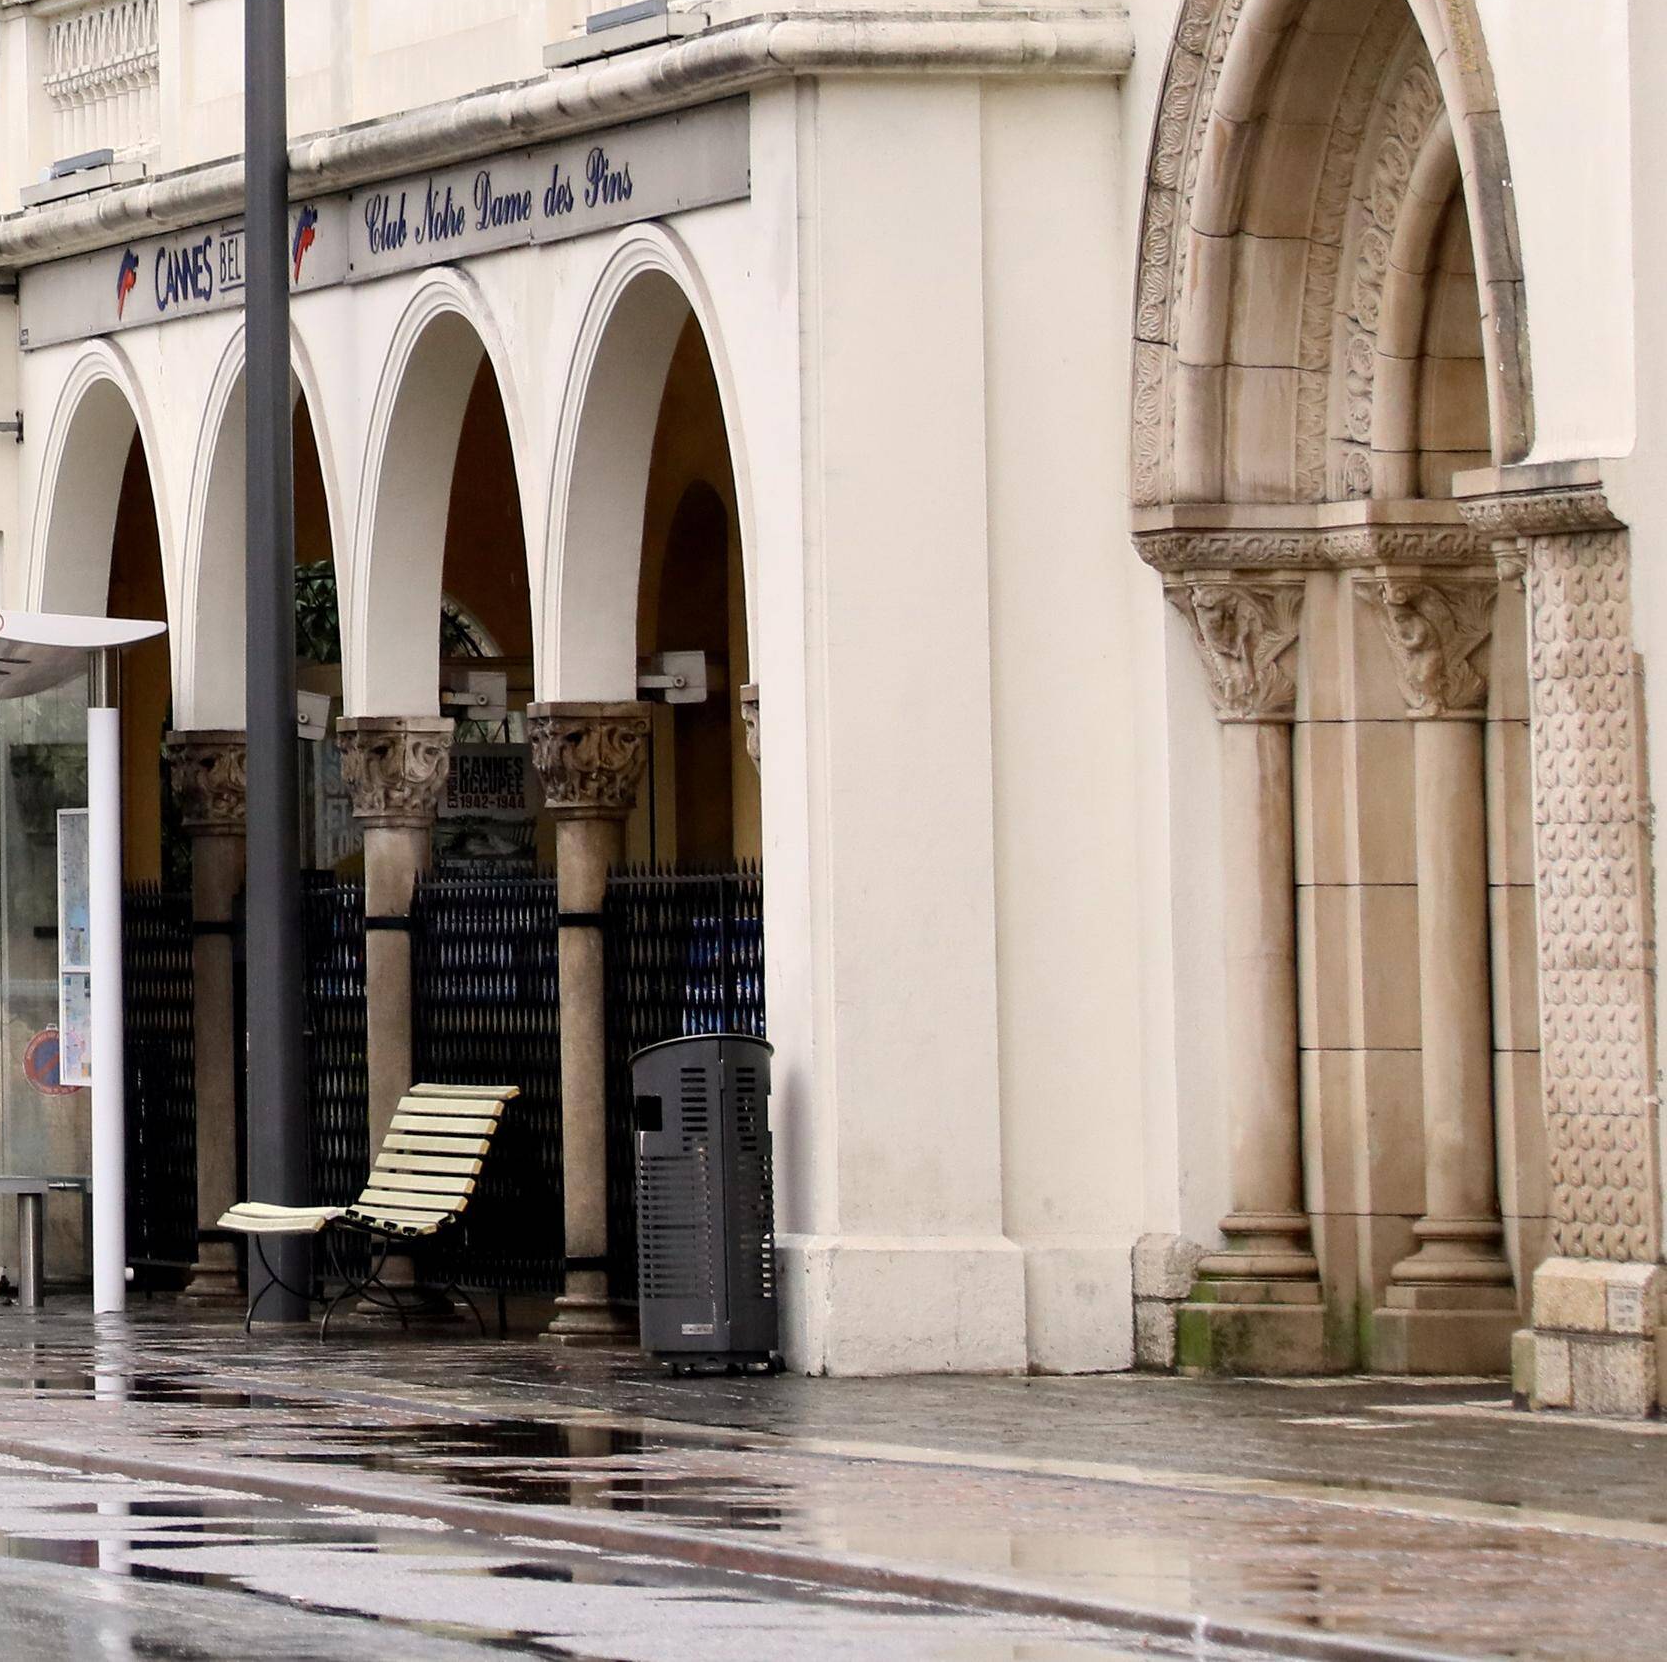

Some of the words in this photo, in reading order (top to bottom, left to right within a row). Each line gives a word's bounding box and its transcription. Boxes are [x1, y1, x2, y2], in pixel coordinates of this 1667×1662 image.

[364, 193, 408, 255] Club
[415, 176, 466, 244] Notre
[474, 170, 533, 231] Dame
[543, 164, 575, 218] des
[584, 146, 634, 209] Pins
[154, 235, 214, 312] CANNES
[219, 237, 242, 284] BEL
[459, 756, 525, 778] CANNES
